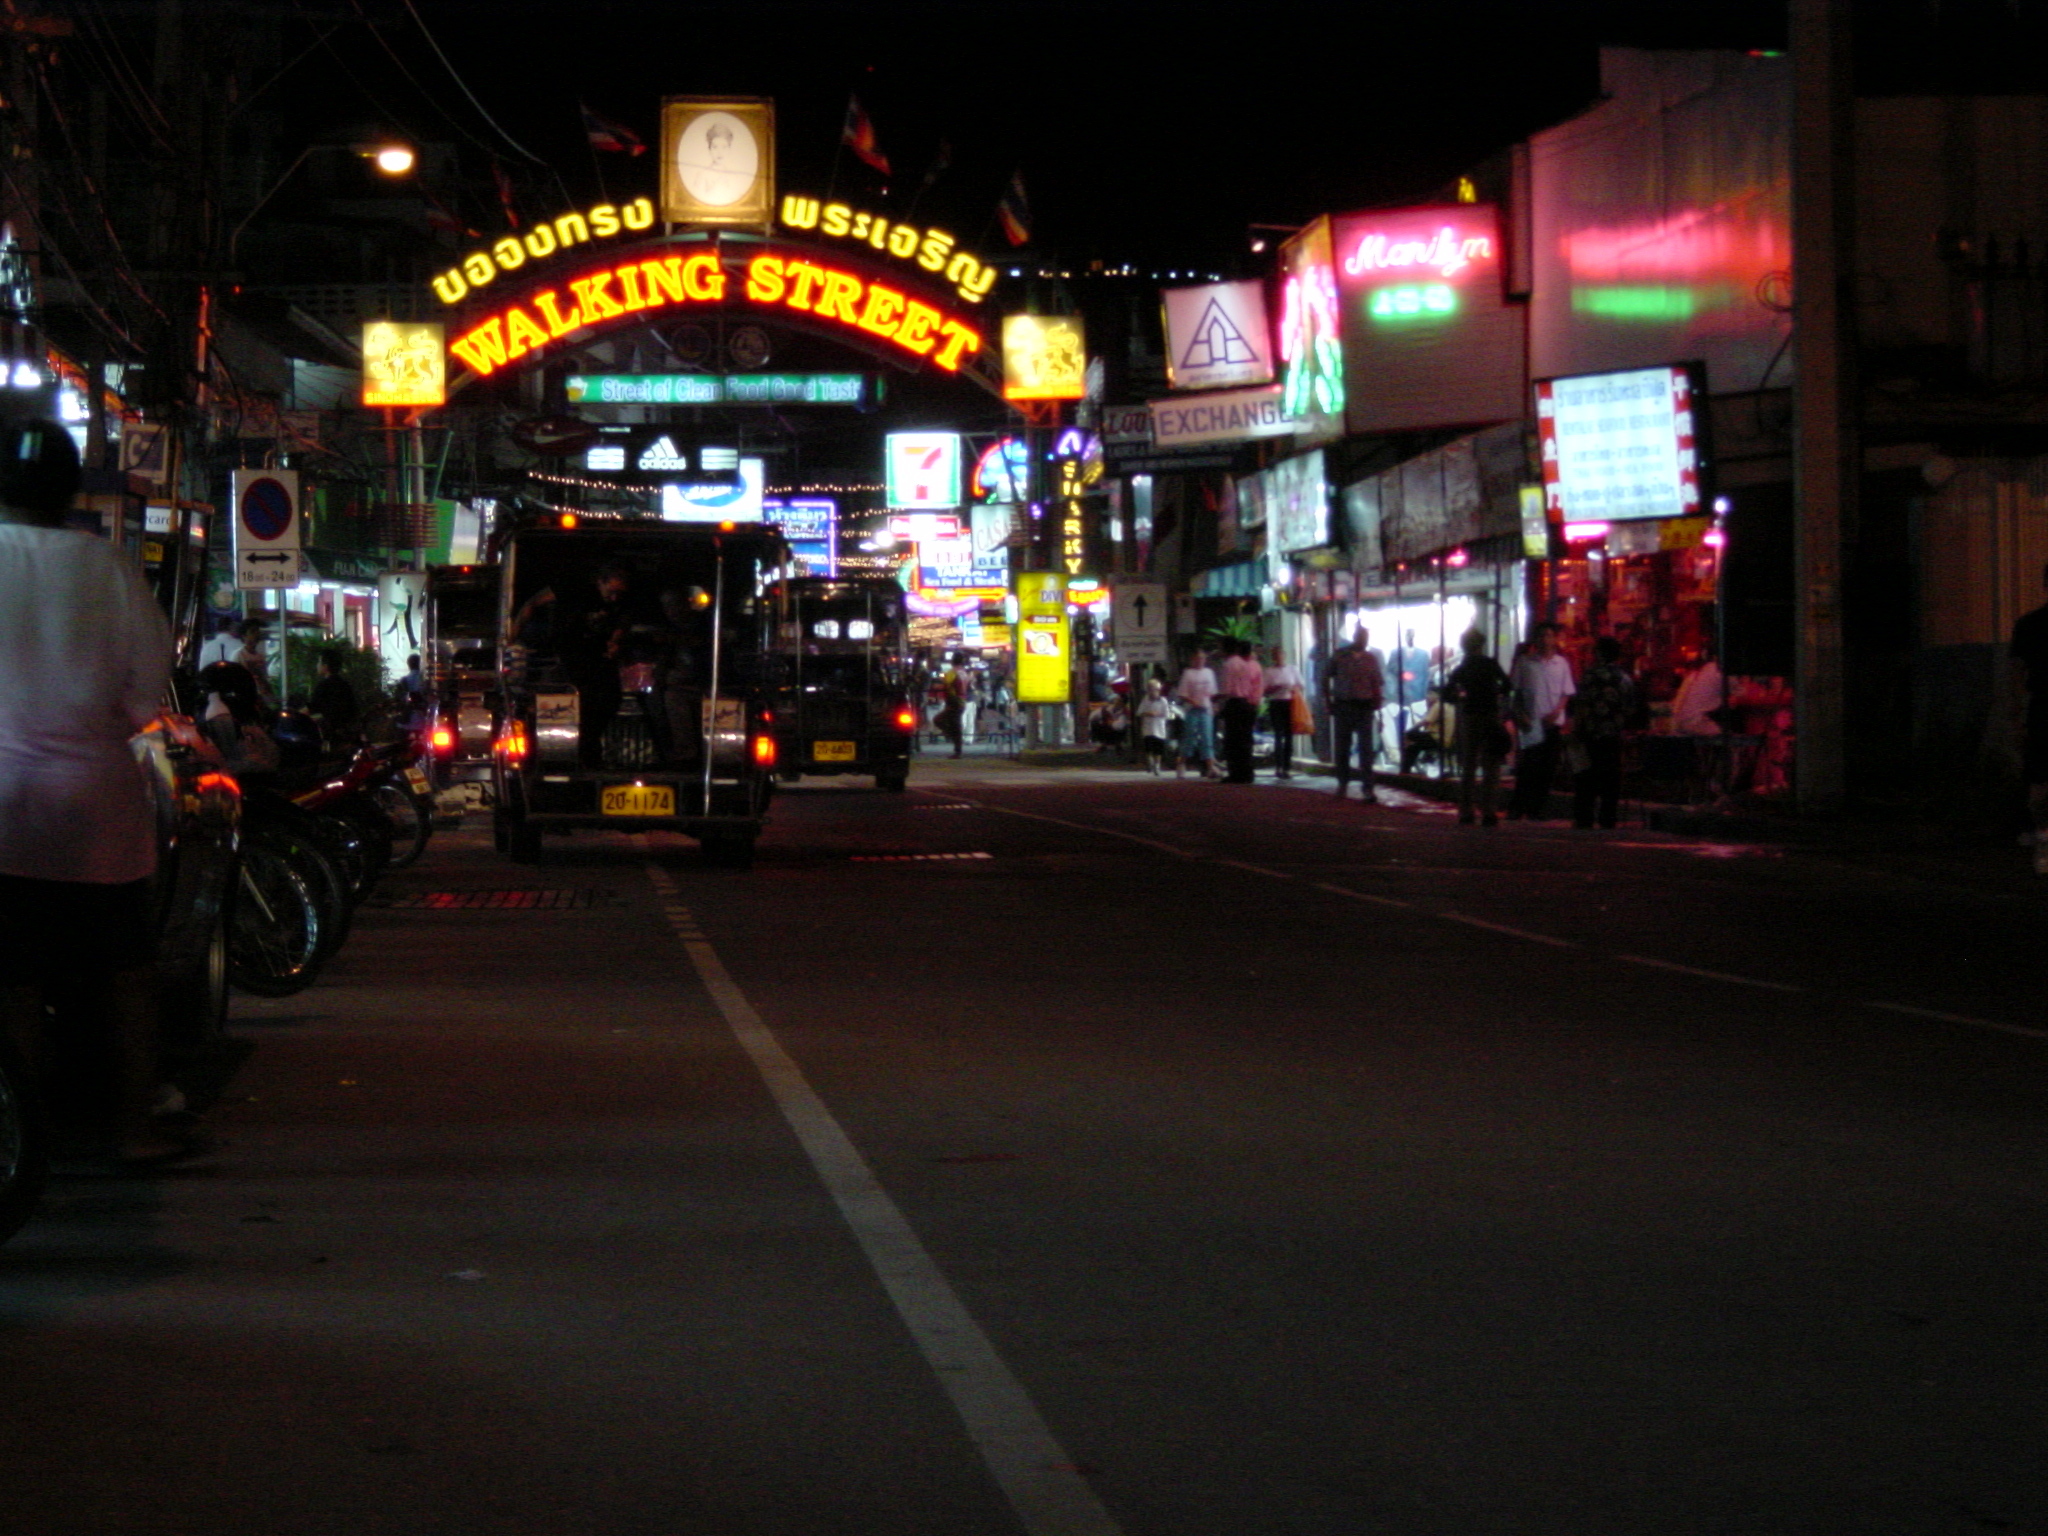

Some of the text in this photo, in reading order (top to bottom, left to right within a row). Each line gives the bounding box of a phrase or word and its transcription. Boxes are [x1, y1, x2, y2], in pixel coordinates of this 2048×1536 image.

[1344, 227, 1491, 277] Marilyn
[450, 253, 980, 376] WALKING STREET
[601, 378, 651, 401] Street
[653, 378, 671, 401] of
[676, 378, 722, 401] Clean
[726, 377, 769, 401] Food
[772, 377, 816, 401] Good
[1159, 400, 1294, 436] EXCHANGE
[605, 791, 670, 810] 20-1174
